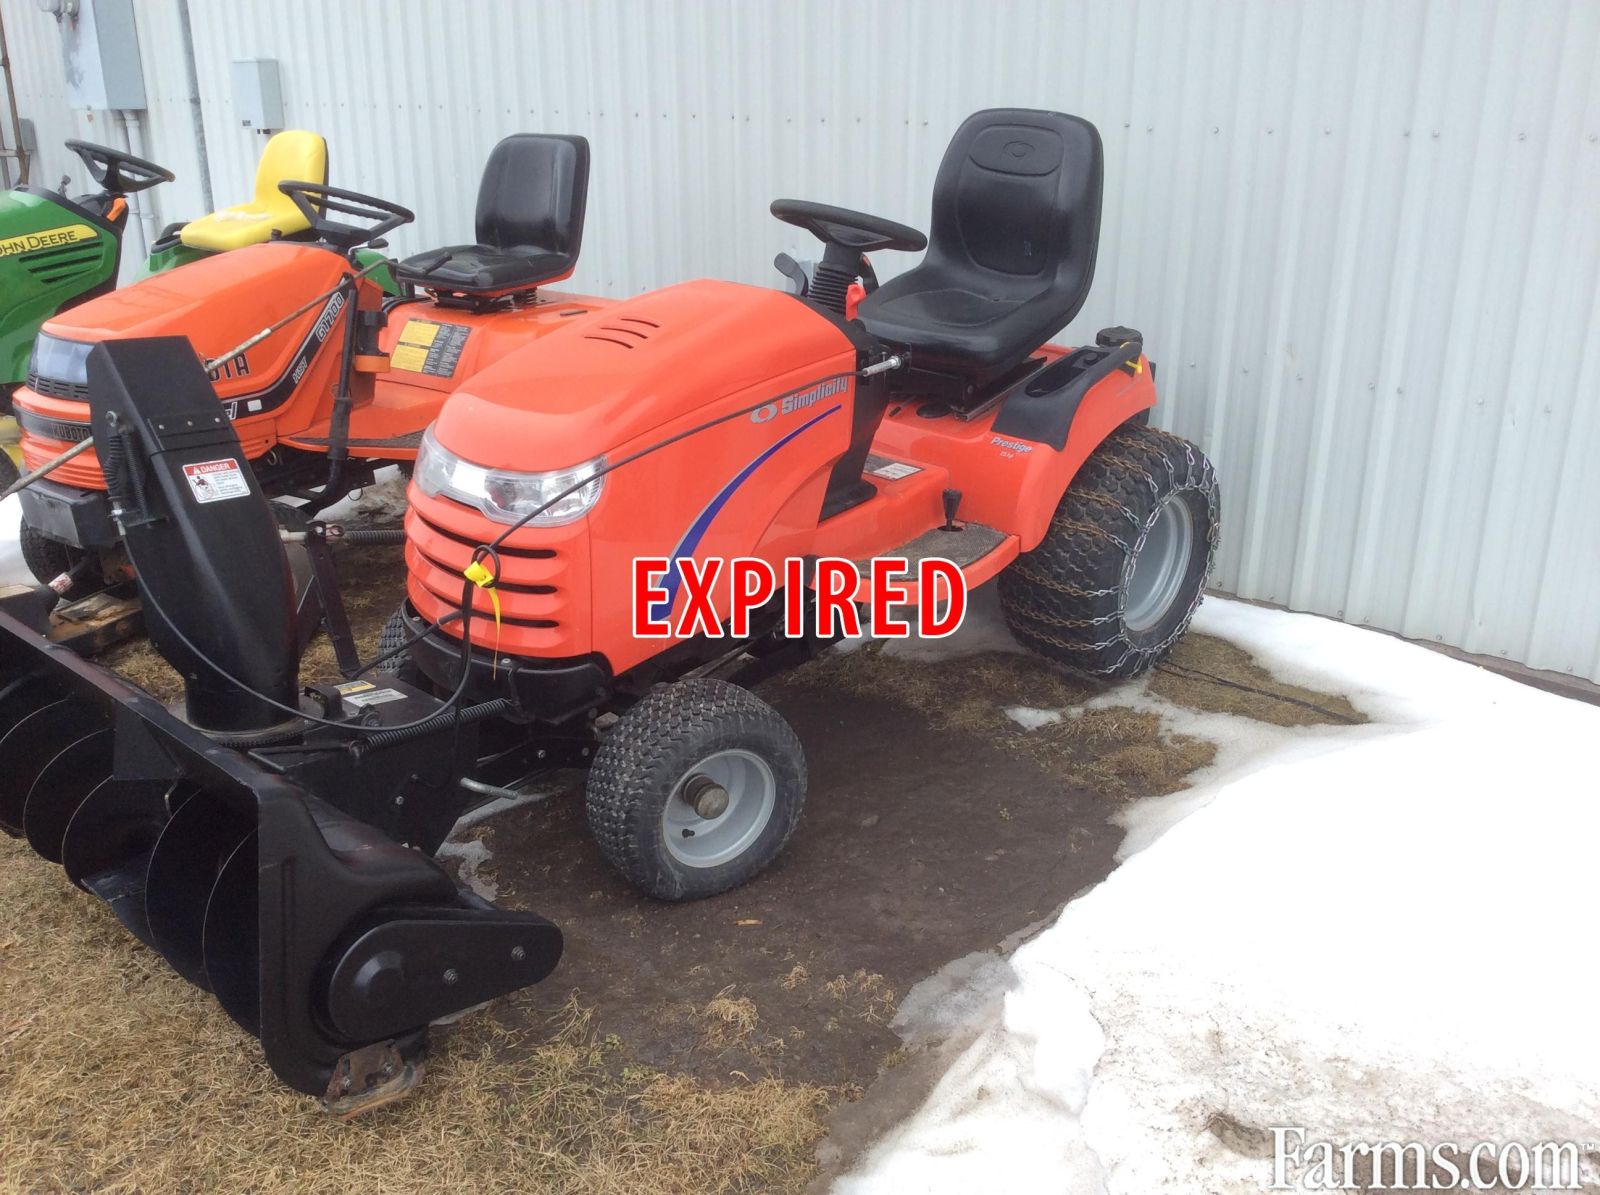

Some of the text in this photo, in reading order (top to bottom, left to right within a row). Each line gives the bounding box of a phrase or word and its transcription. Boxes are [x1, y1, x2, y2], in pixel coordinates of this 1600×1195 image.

[26, 230, 78, 249] DEERE
[315, 291, 345, 342] G1700
[781, 376, 848, 416] Simplicity
[991, 436, 1033, 453] Prestige
[201, 462, 230, 473] DANGER
